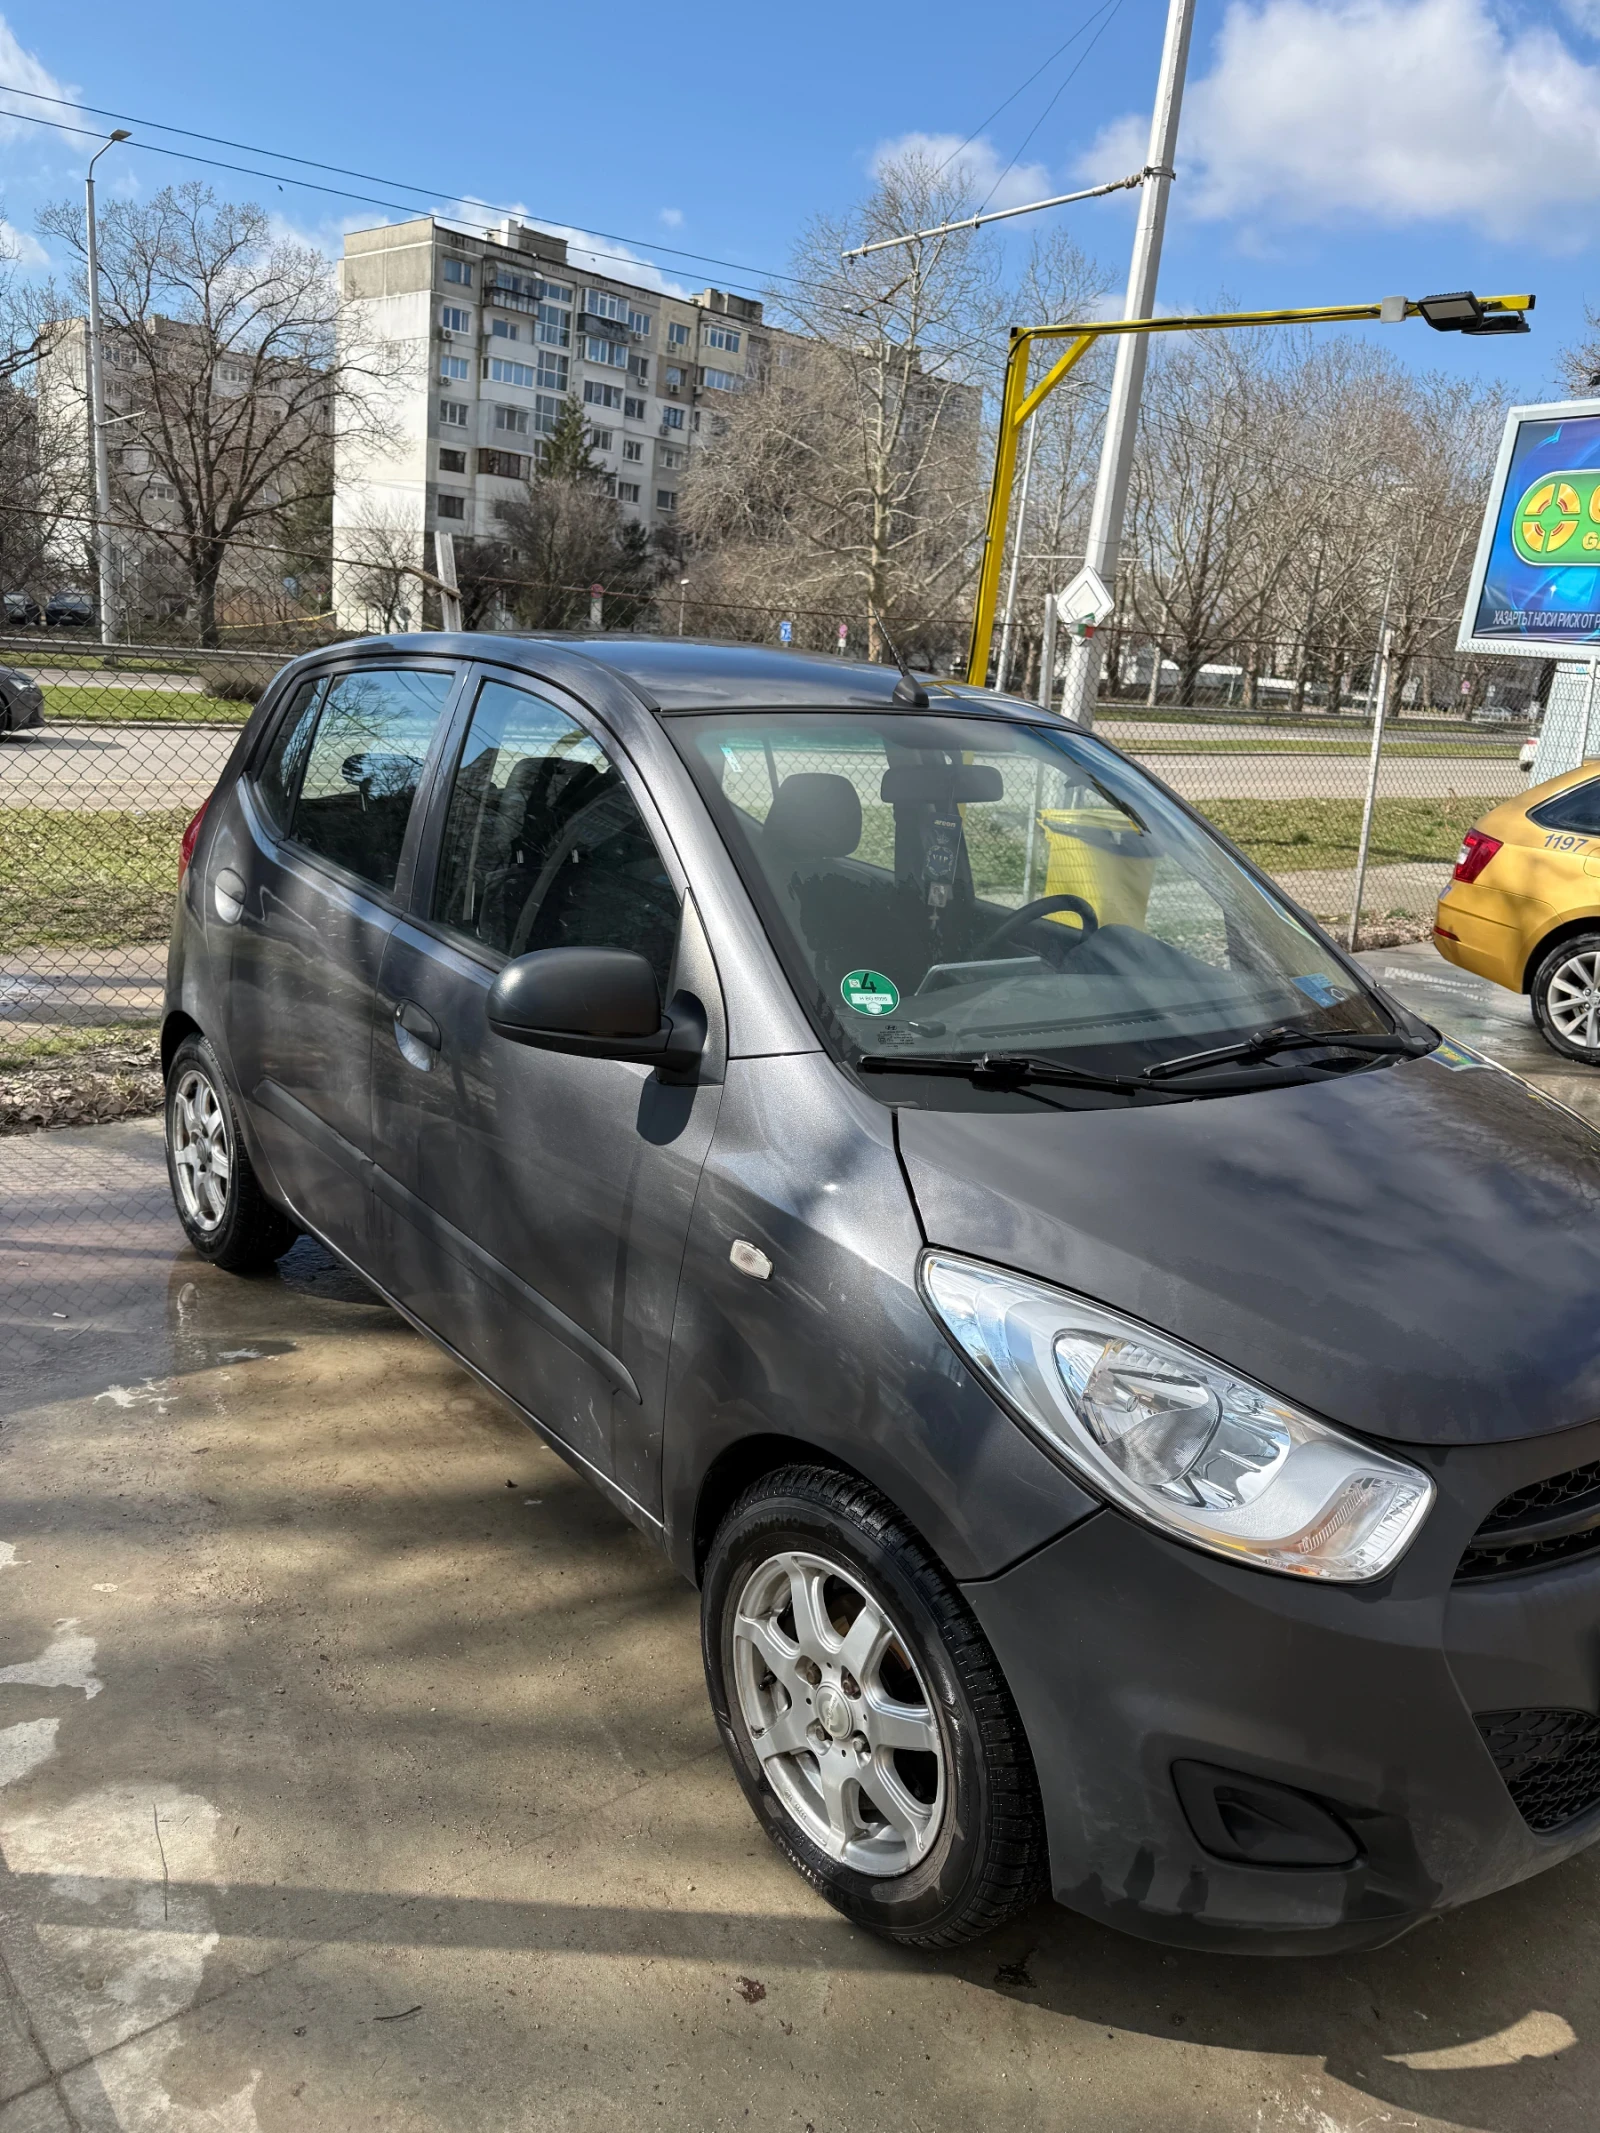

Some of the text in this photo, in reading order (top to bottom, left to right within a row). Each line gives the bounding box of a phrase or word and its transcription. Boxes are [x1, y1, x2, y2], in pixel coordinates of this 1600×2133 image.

[1492, 609, 1534, 626] ХАЗАРТЪТ
[1532, 611, 1558, 627] НОСИ
[1557, 612, 1582, 629] РИСК
[1581, 613, 1595, 629] ОТ
[1544, 833, 1589, 852] 1197
[932, 853, 949, 862] VIP
[861, 973, 877, 993] 4
